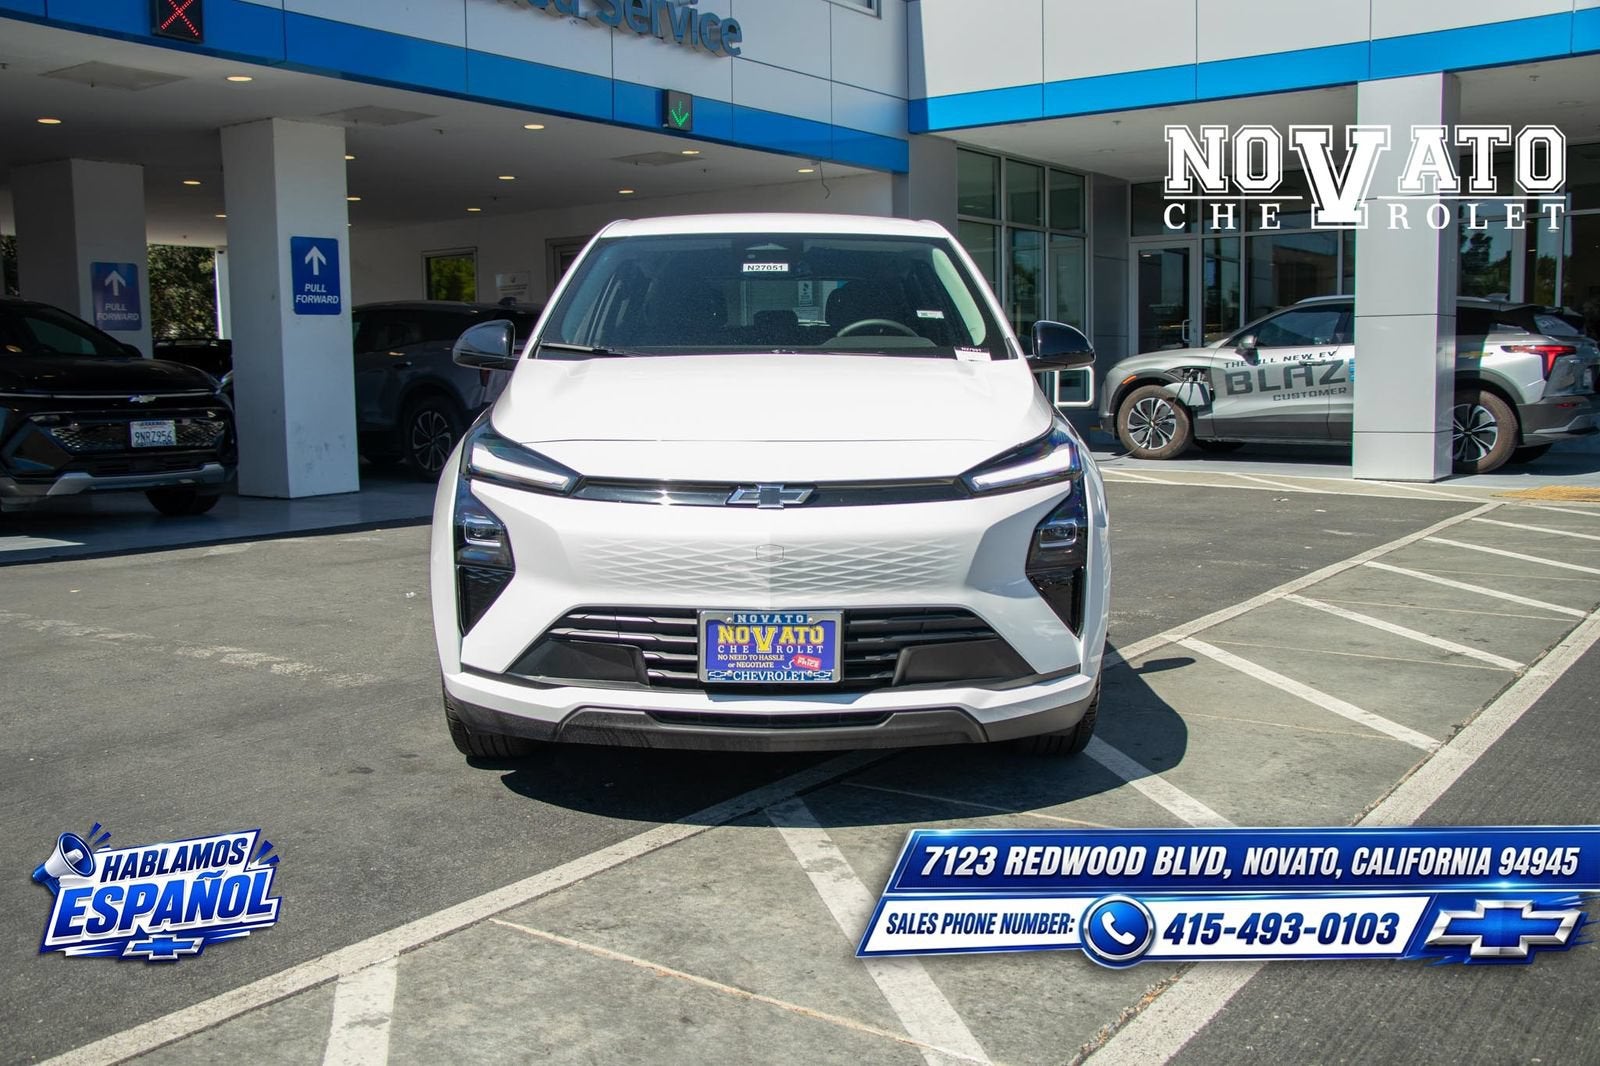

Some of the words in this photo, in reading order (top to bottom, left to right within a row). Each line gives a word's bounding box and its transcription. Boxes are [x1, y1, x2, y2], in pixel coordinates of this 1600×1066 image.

[304, 283, 327, 293] PULL
[295, 294, 339, 304] FORWARD
[105, 303, 128, 311] PULL
[96, 312, 140, 321] FORWARD
[1224, 360, 1247, 369] THE
[1283, 352, 1315, 362] NEW
[1318, 350, 1337, 358] EV
[1224, 358, 1355, 396] BLAZ
[1272, 386, 1348, 402] CUSTOMER
[134, 430, 173, 443] 9NRZ956
[737, 613, 805, 624] NOVATO
[717, 625, 825, 653] NOVATO
[732, 670, 807, 681] CHEVROLET
